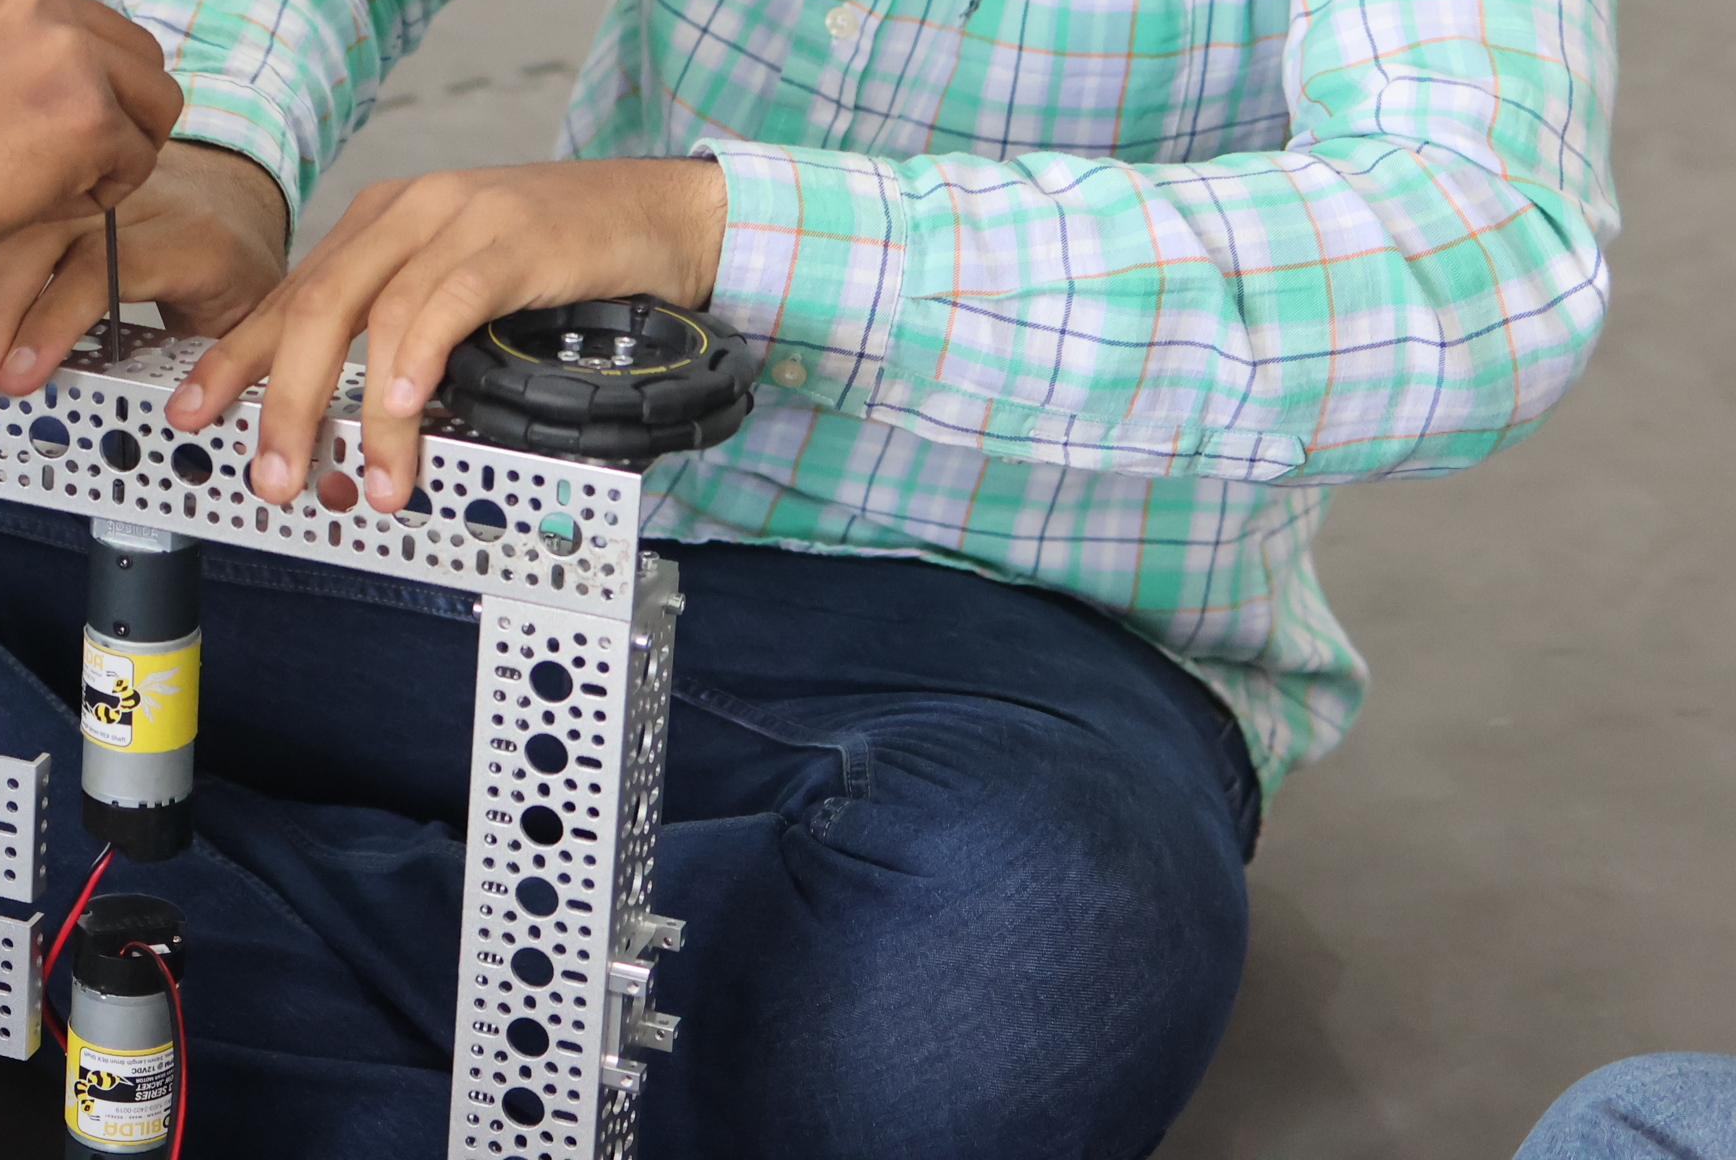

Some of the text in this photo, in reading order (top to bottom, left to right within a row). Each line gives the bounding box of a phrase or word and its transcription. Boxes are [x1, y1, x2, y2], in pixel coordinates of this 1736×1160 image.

[83, 1051, 96, 1060] Shaft
[126, 1058, 146, 1066] Length
[157, 1062, 164, 1070] @
[132, 1066, 155, 1074] 12VDC
[136, 1076, 154, 1084] MOTOR
[136, 1078, 165, 1092] JACKET
[134, 1085, 168, 1101] SERIES
